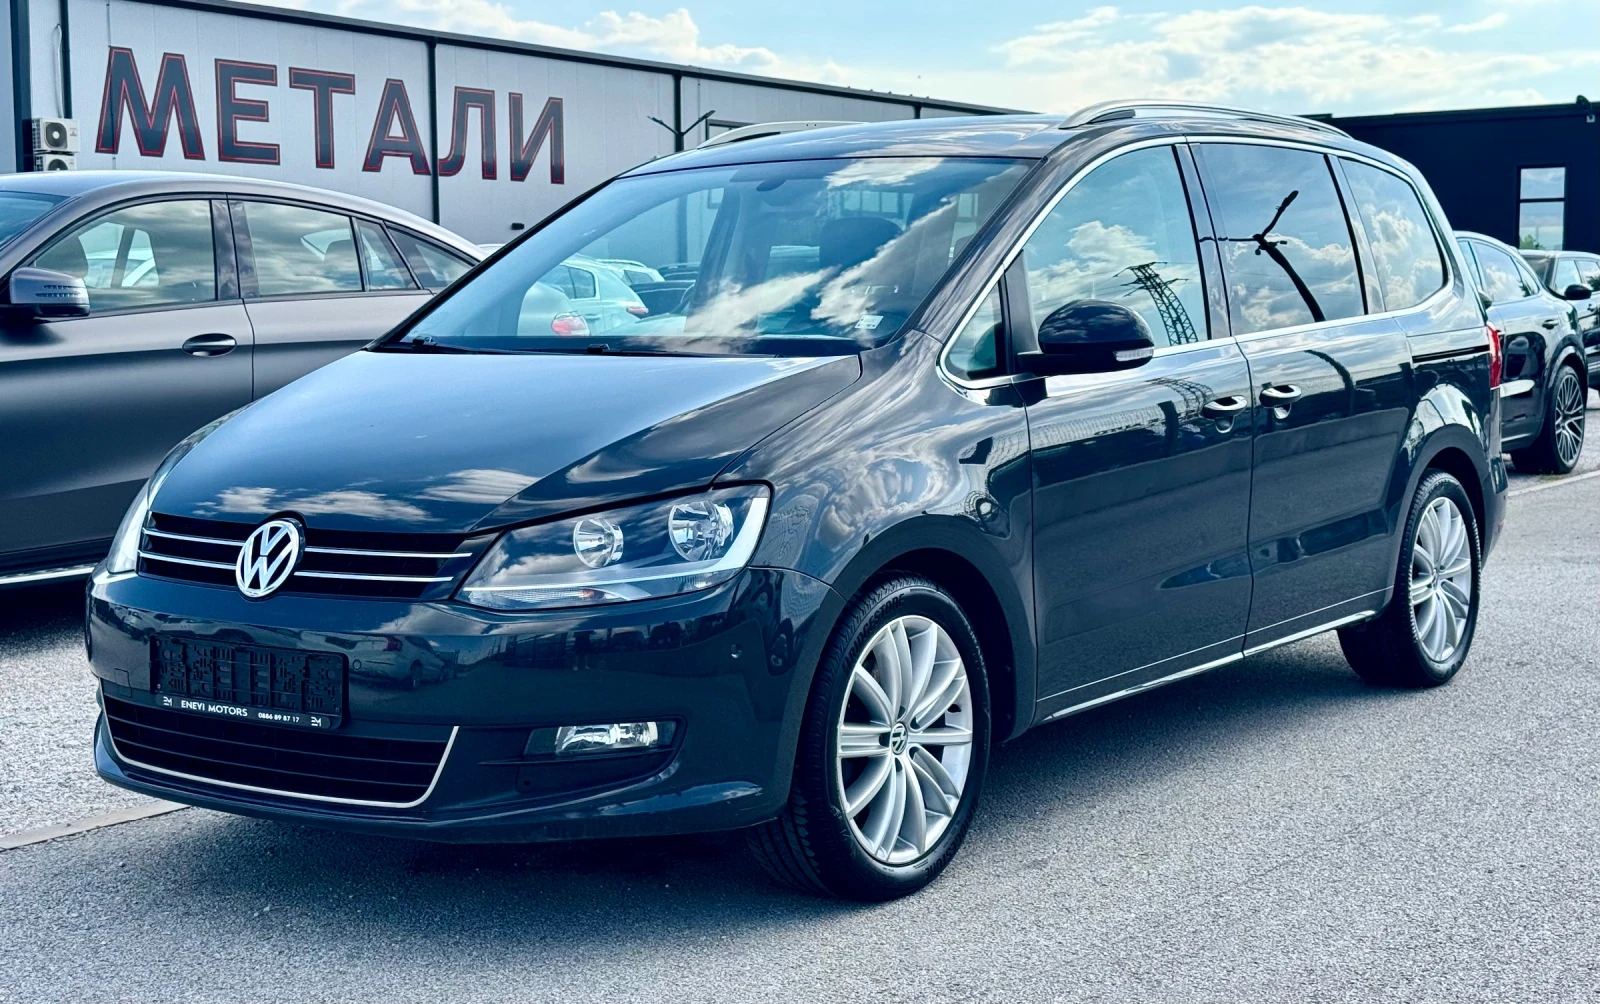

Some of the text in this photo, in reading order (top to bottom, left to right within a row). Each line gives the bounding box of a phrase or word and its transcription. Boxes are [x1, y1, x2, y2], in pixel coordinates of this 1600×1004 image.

[95, 45, 565, 185] МЕТАЛИ
[236, 520, 300, 598] VW
[181, 700, 248, 717] ENEVI MOTORS
